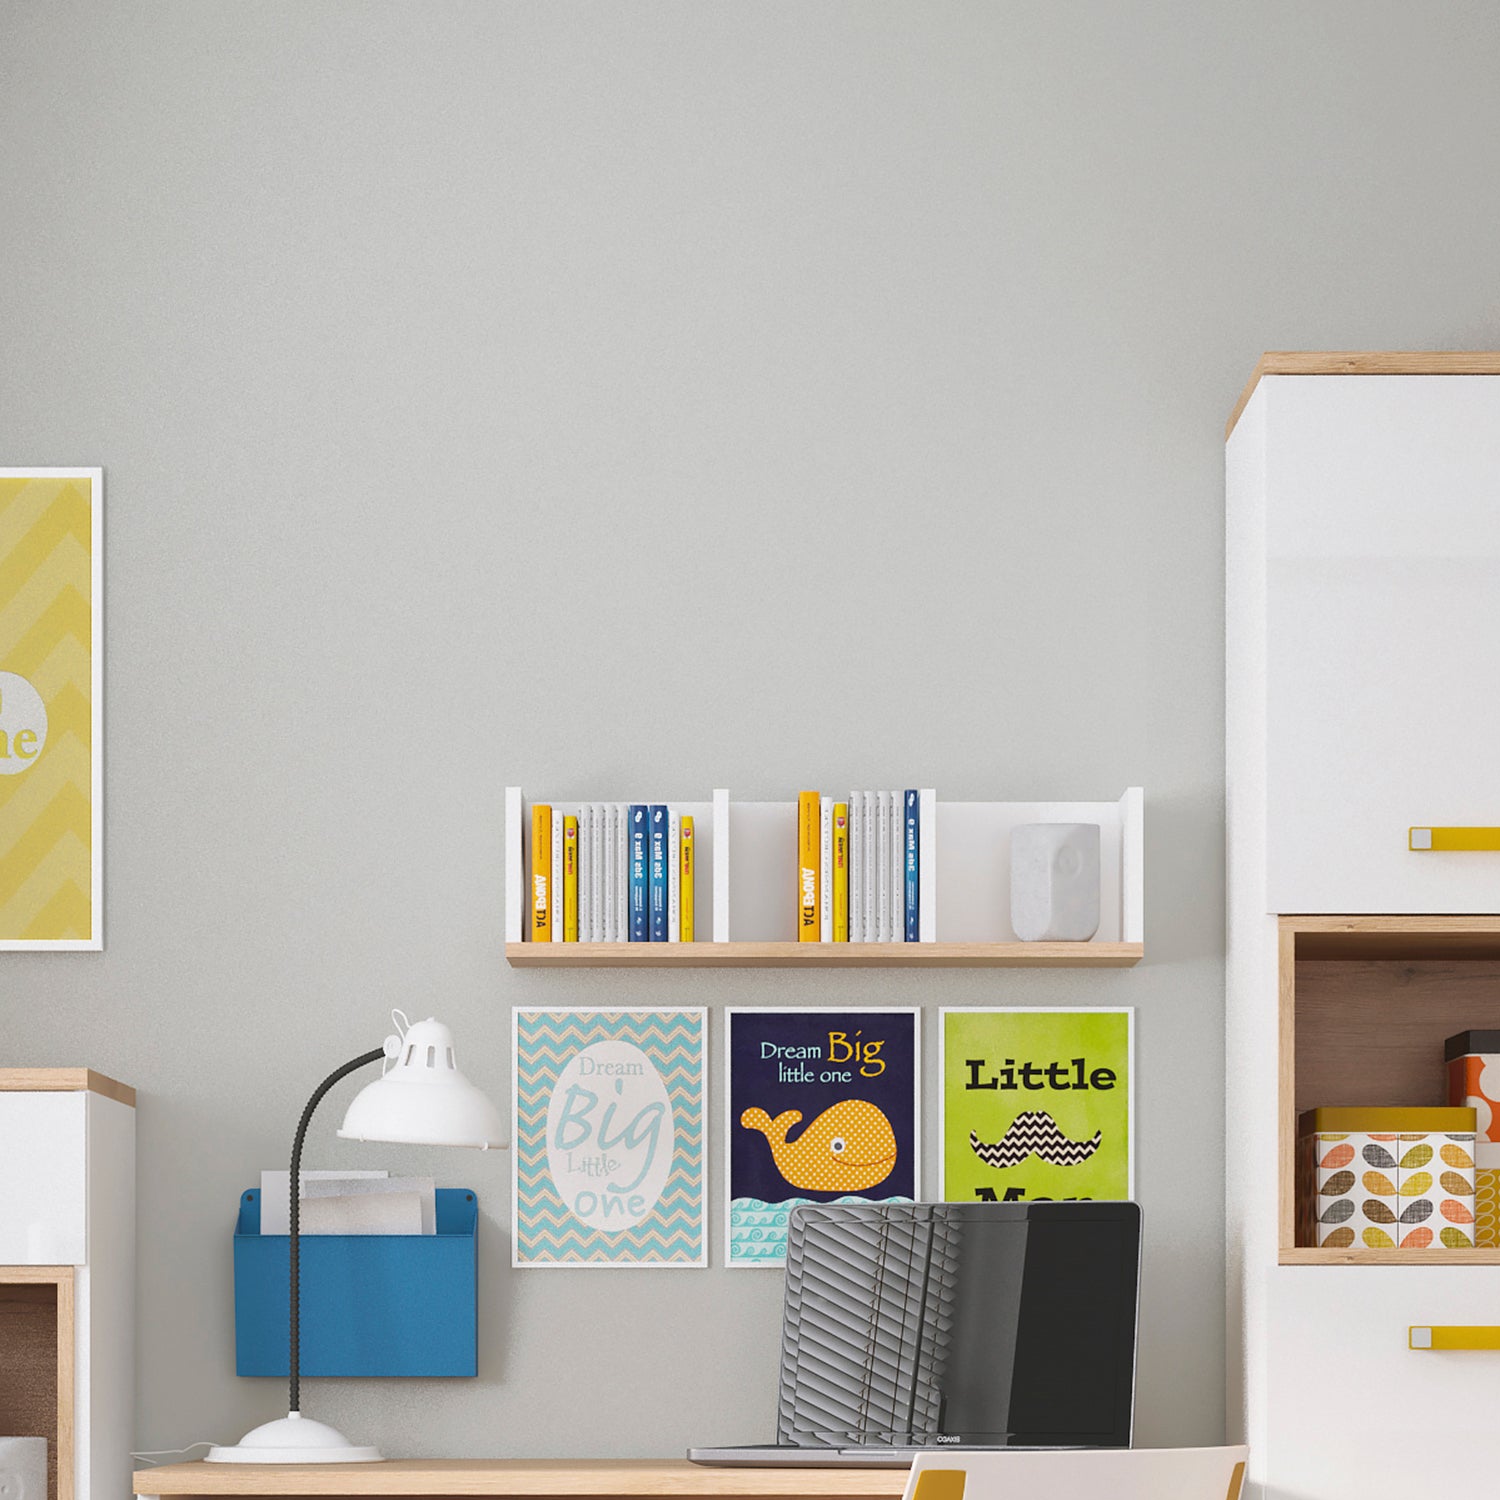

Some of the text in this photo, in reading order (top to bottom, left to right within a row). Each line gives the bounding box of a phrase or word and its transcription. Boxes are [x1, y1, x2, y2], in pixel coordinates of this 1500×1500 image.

[579, 1056, 644, 1076] Dream
[760, 1030, 886, 1077] Dream Big
[778, 1061, 852, 1083] little one
[965, 1057, 1117, 1091] Little
[554, 1078, 666, 1194] Big
[565, 1151, 622, 1177] Little
